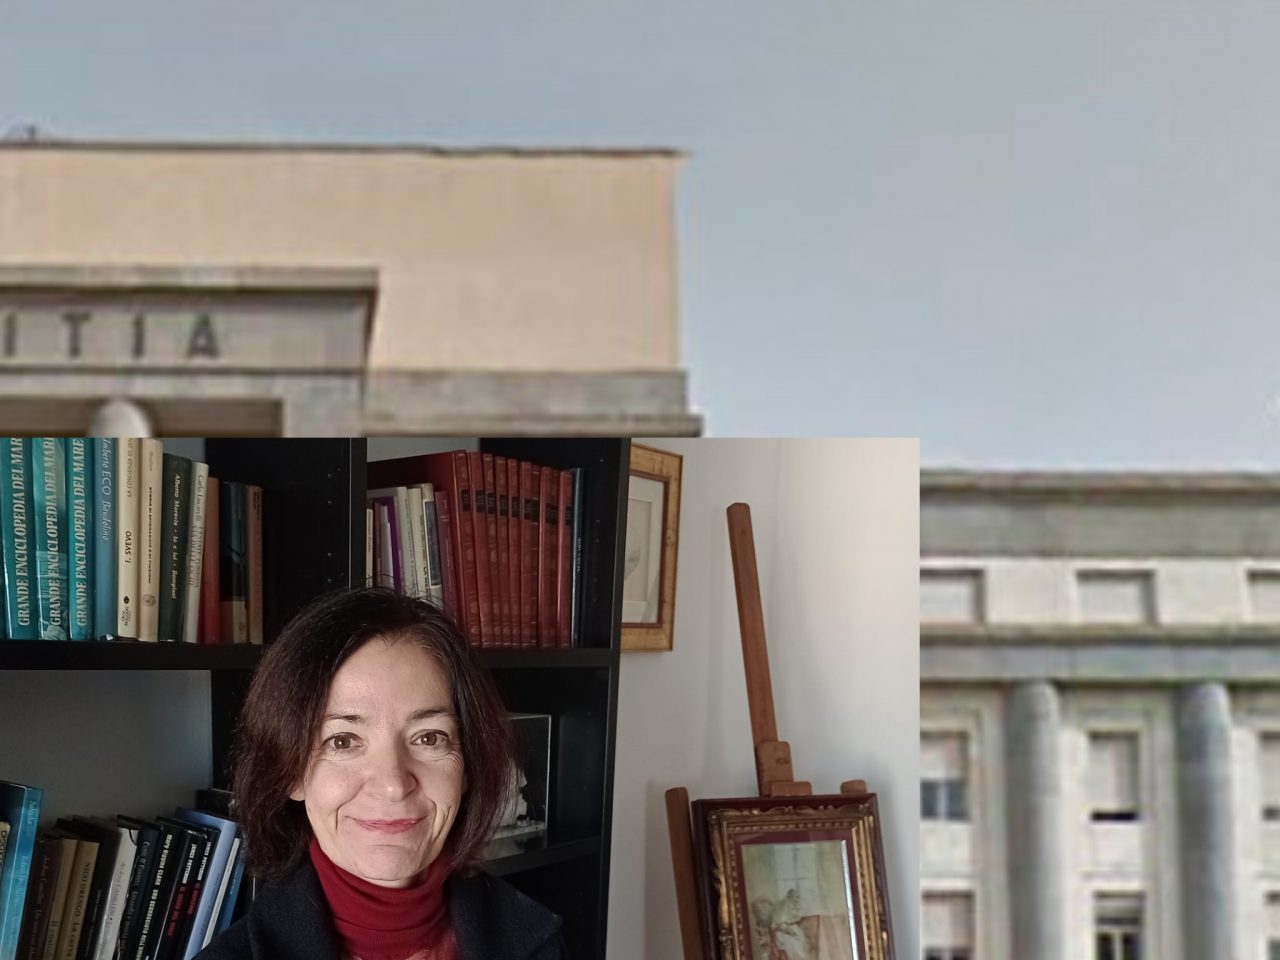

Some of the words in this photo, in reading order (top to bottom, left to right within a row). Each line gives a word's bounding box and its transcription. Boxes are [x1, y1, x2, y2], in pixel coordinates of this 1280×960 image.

[73, 439, 84, 472] MARE
[11, 462, 24, 490] DEL
[45, 467, 56, 492] DEL
[73, 474, 85, 496] DEL
[102, 473, 112, 496] ECO
[196, 474, 204, 493] Carlo
[102, 501, 112, 541] Baudolino
[195, 494, 203, 521] Lucarelli
[13, 492, 28, 576] ENCICLOPEDIA
[46, 495, 60, 577] ENCICLOPEDIA
[75, 499, 87, 578] ENCICLOPEDIA
[169, 569, 177, 598] Bompiani
[17, 579, 30, 626] GRANDE
[49, 580, 61, 626] GRANDE
[77, 581, 87, 626] GRANDE
[164, 833, 172, 849] Mary
[182, 858, 192, 884] PATTERSON
[198, 856, 207, 880] PATTERSON
[72, 921, 79, 933] La
